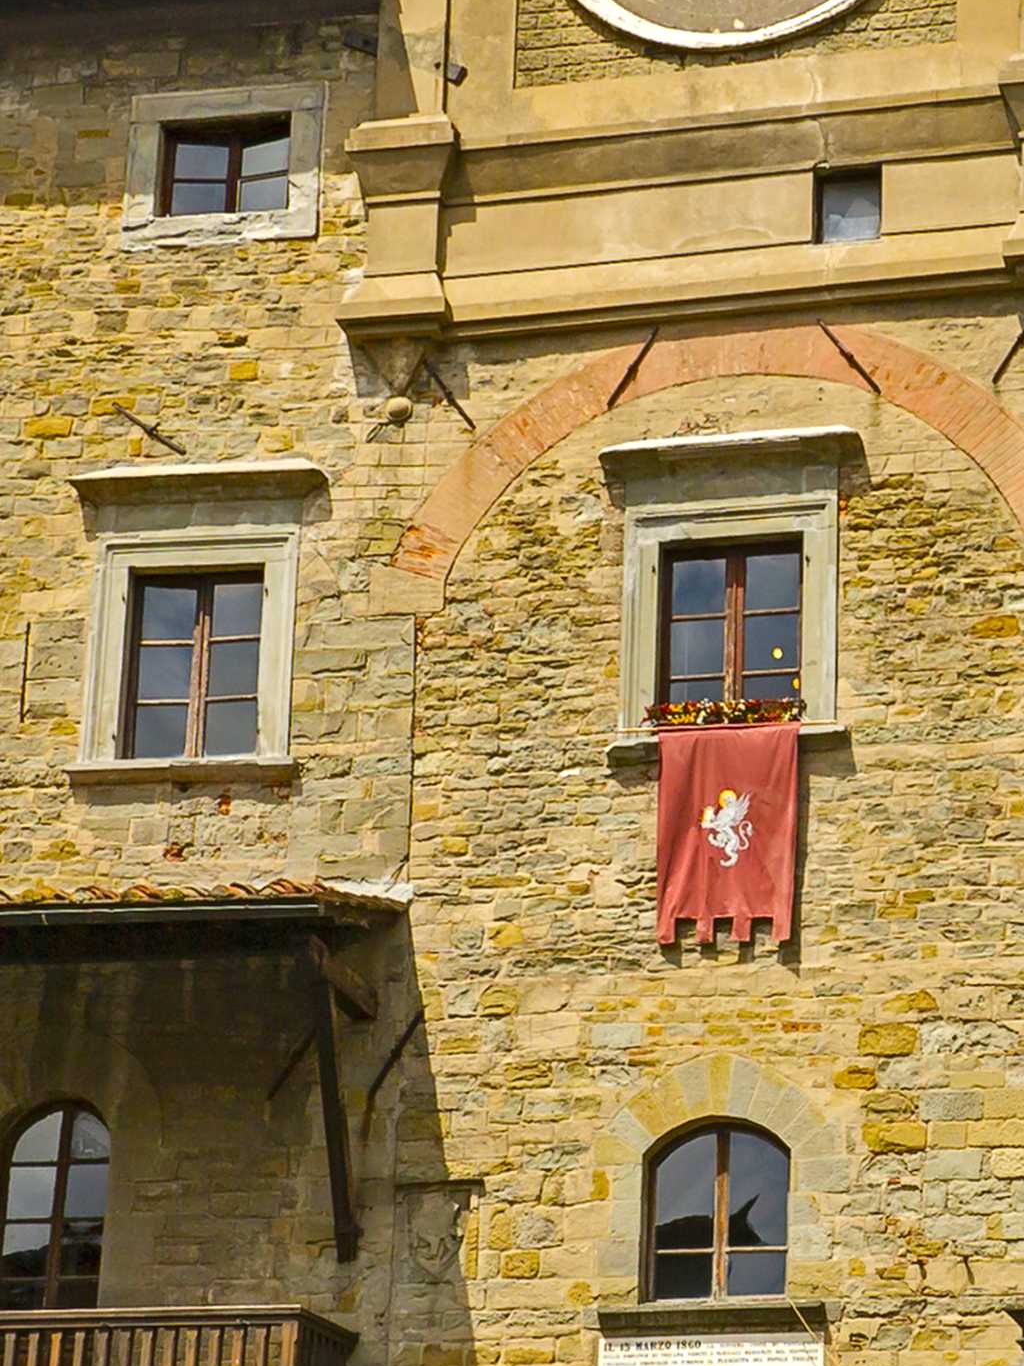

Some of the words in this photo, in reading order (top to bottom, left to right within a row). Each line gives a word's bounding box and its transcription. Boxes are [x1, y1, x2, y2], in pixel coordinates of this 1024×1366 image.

[604, 1342, 615, 1352] IL
[635, 1340, 672, 1352] MARZO
[676, 1339, 702, 1350] 1860
